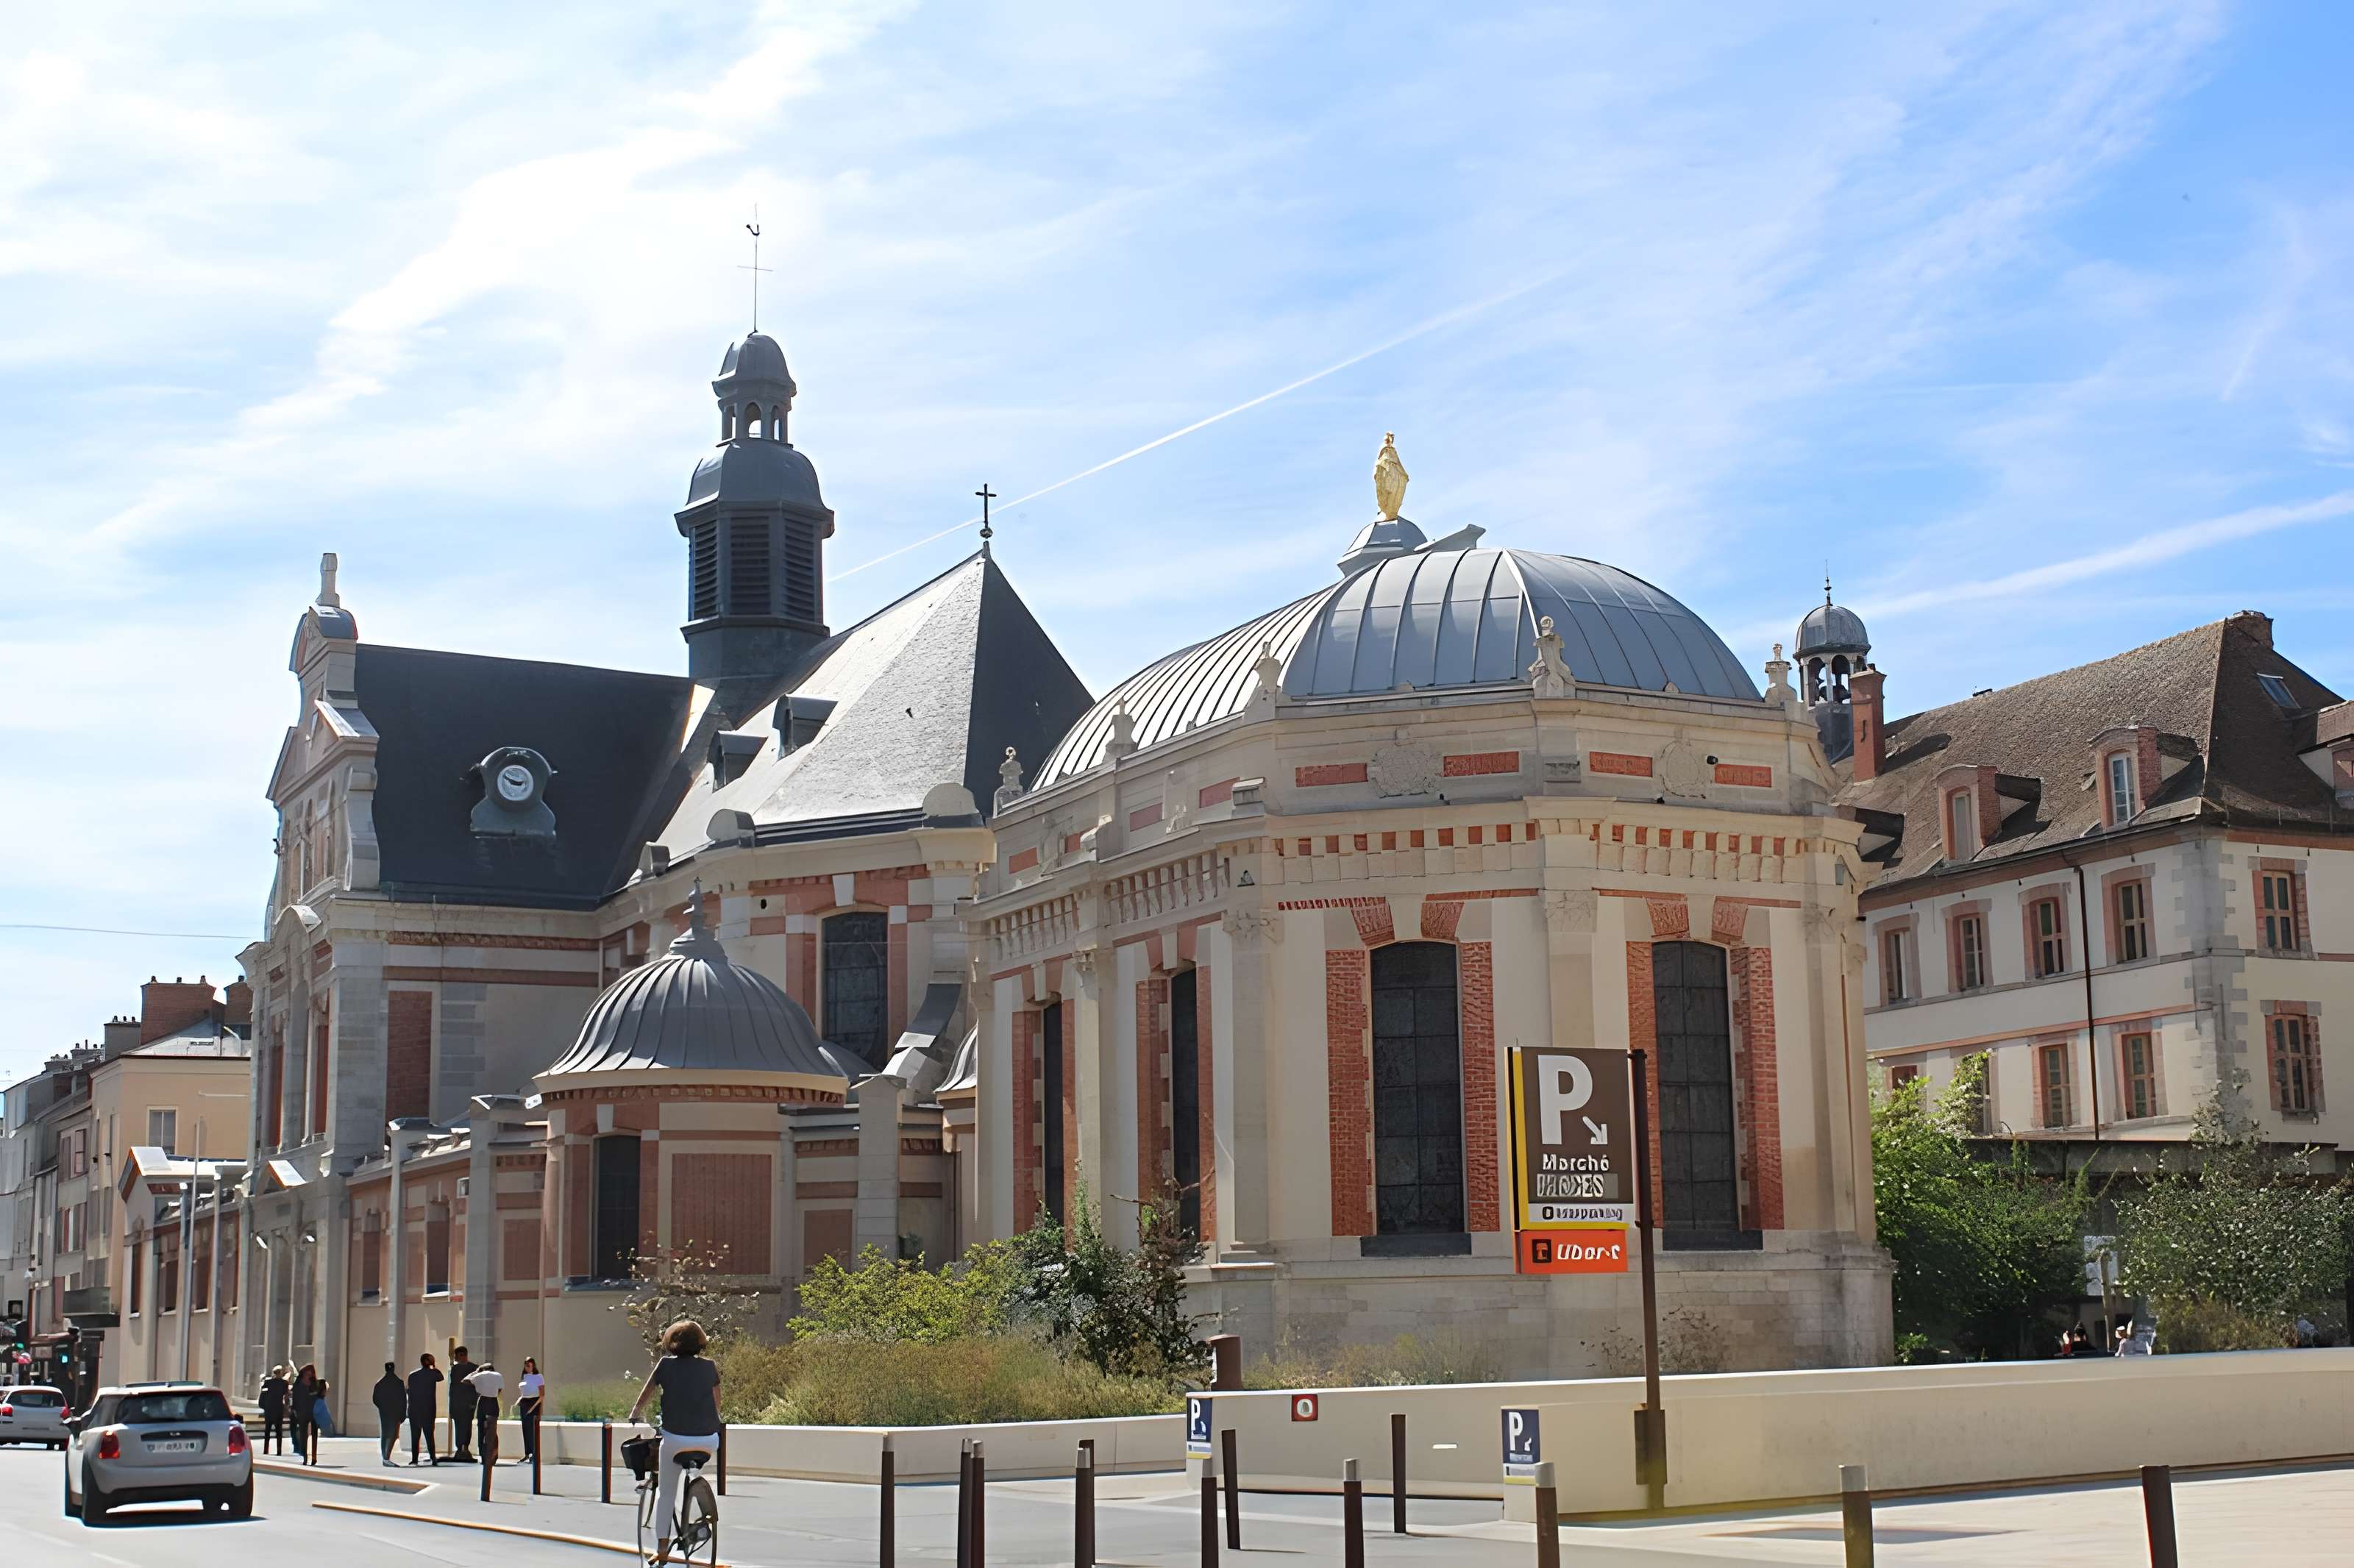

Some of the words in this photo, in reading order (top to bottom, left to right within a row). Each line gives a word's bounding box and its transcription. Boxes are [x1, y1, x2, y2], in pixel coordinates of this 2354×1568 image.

[1538, 1055, 1593, 1144] P
[1191, 1398, 1201, 1430] P
[1508, 1411, 1523, 1451] P
